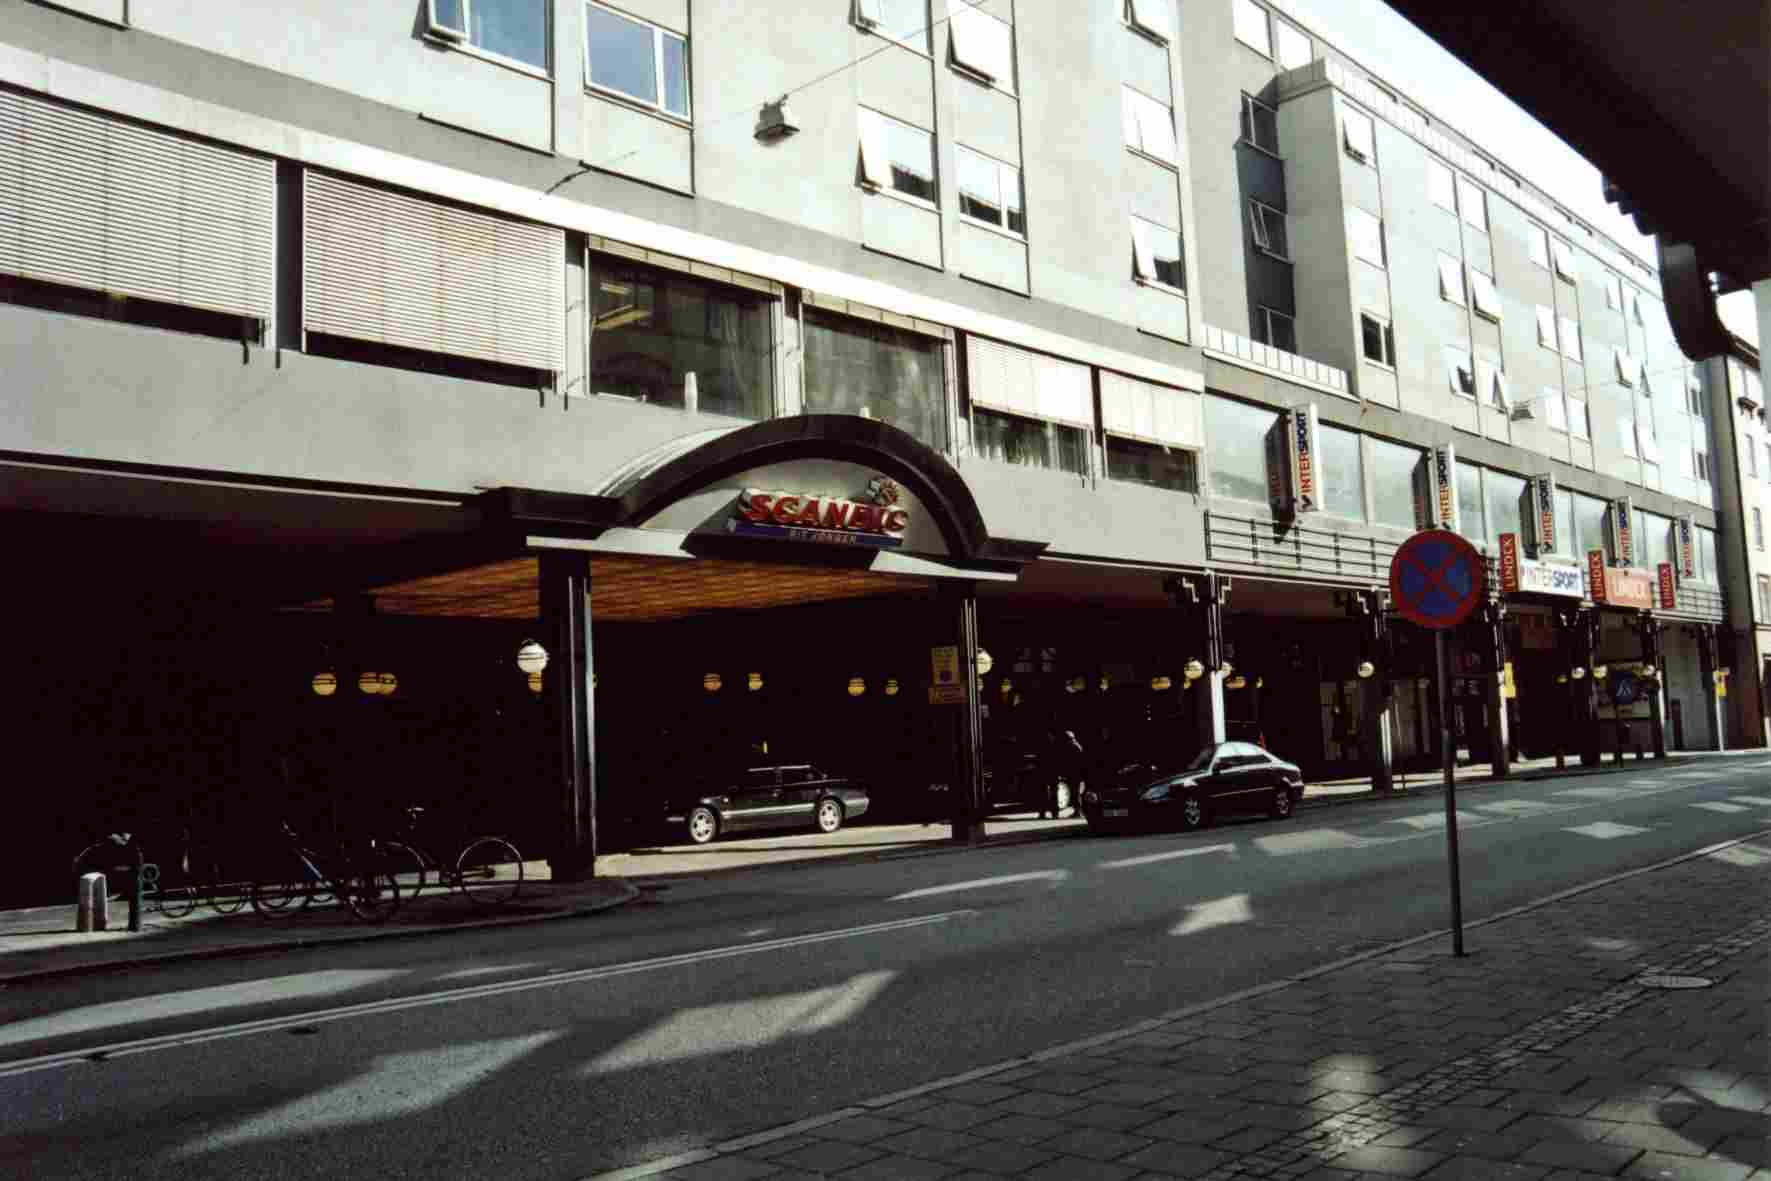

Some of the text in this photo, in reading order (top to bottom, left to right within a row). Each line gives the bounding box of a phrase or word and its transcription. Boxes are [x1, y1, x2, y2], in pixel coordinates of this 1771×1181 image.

[1296, 411, 1312, 493] INTERSPORT
[738, 491, 909, 532] SCANDIC
[1503, 537, 1515, 588] LINDEX
